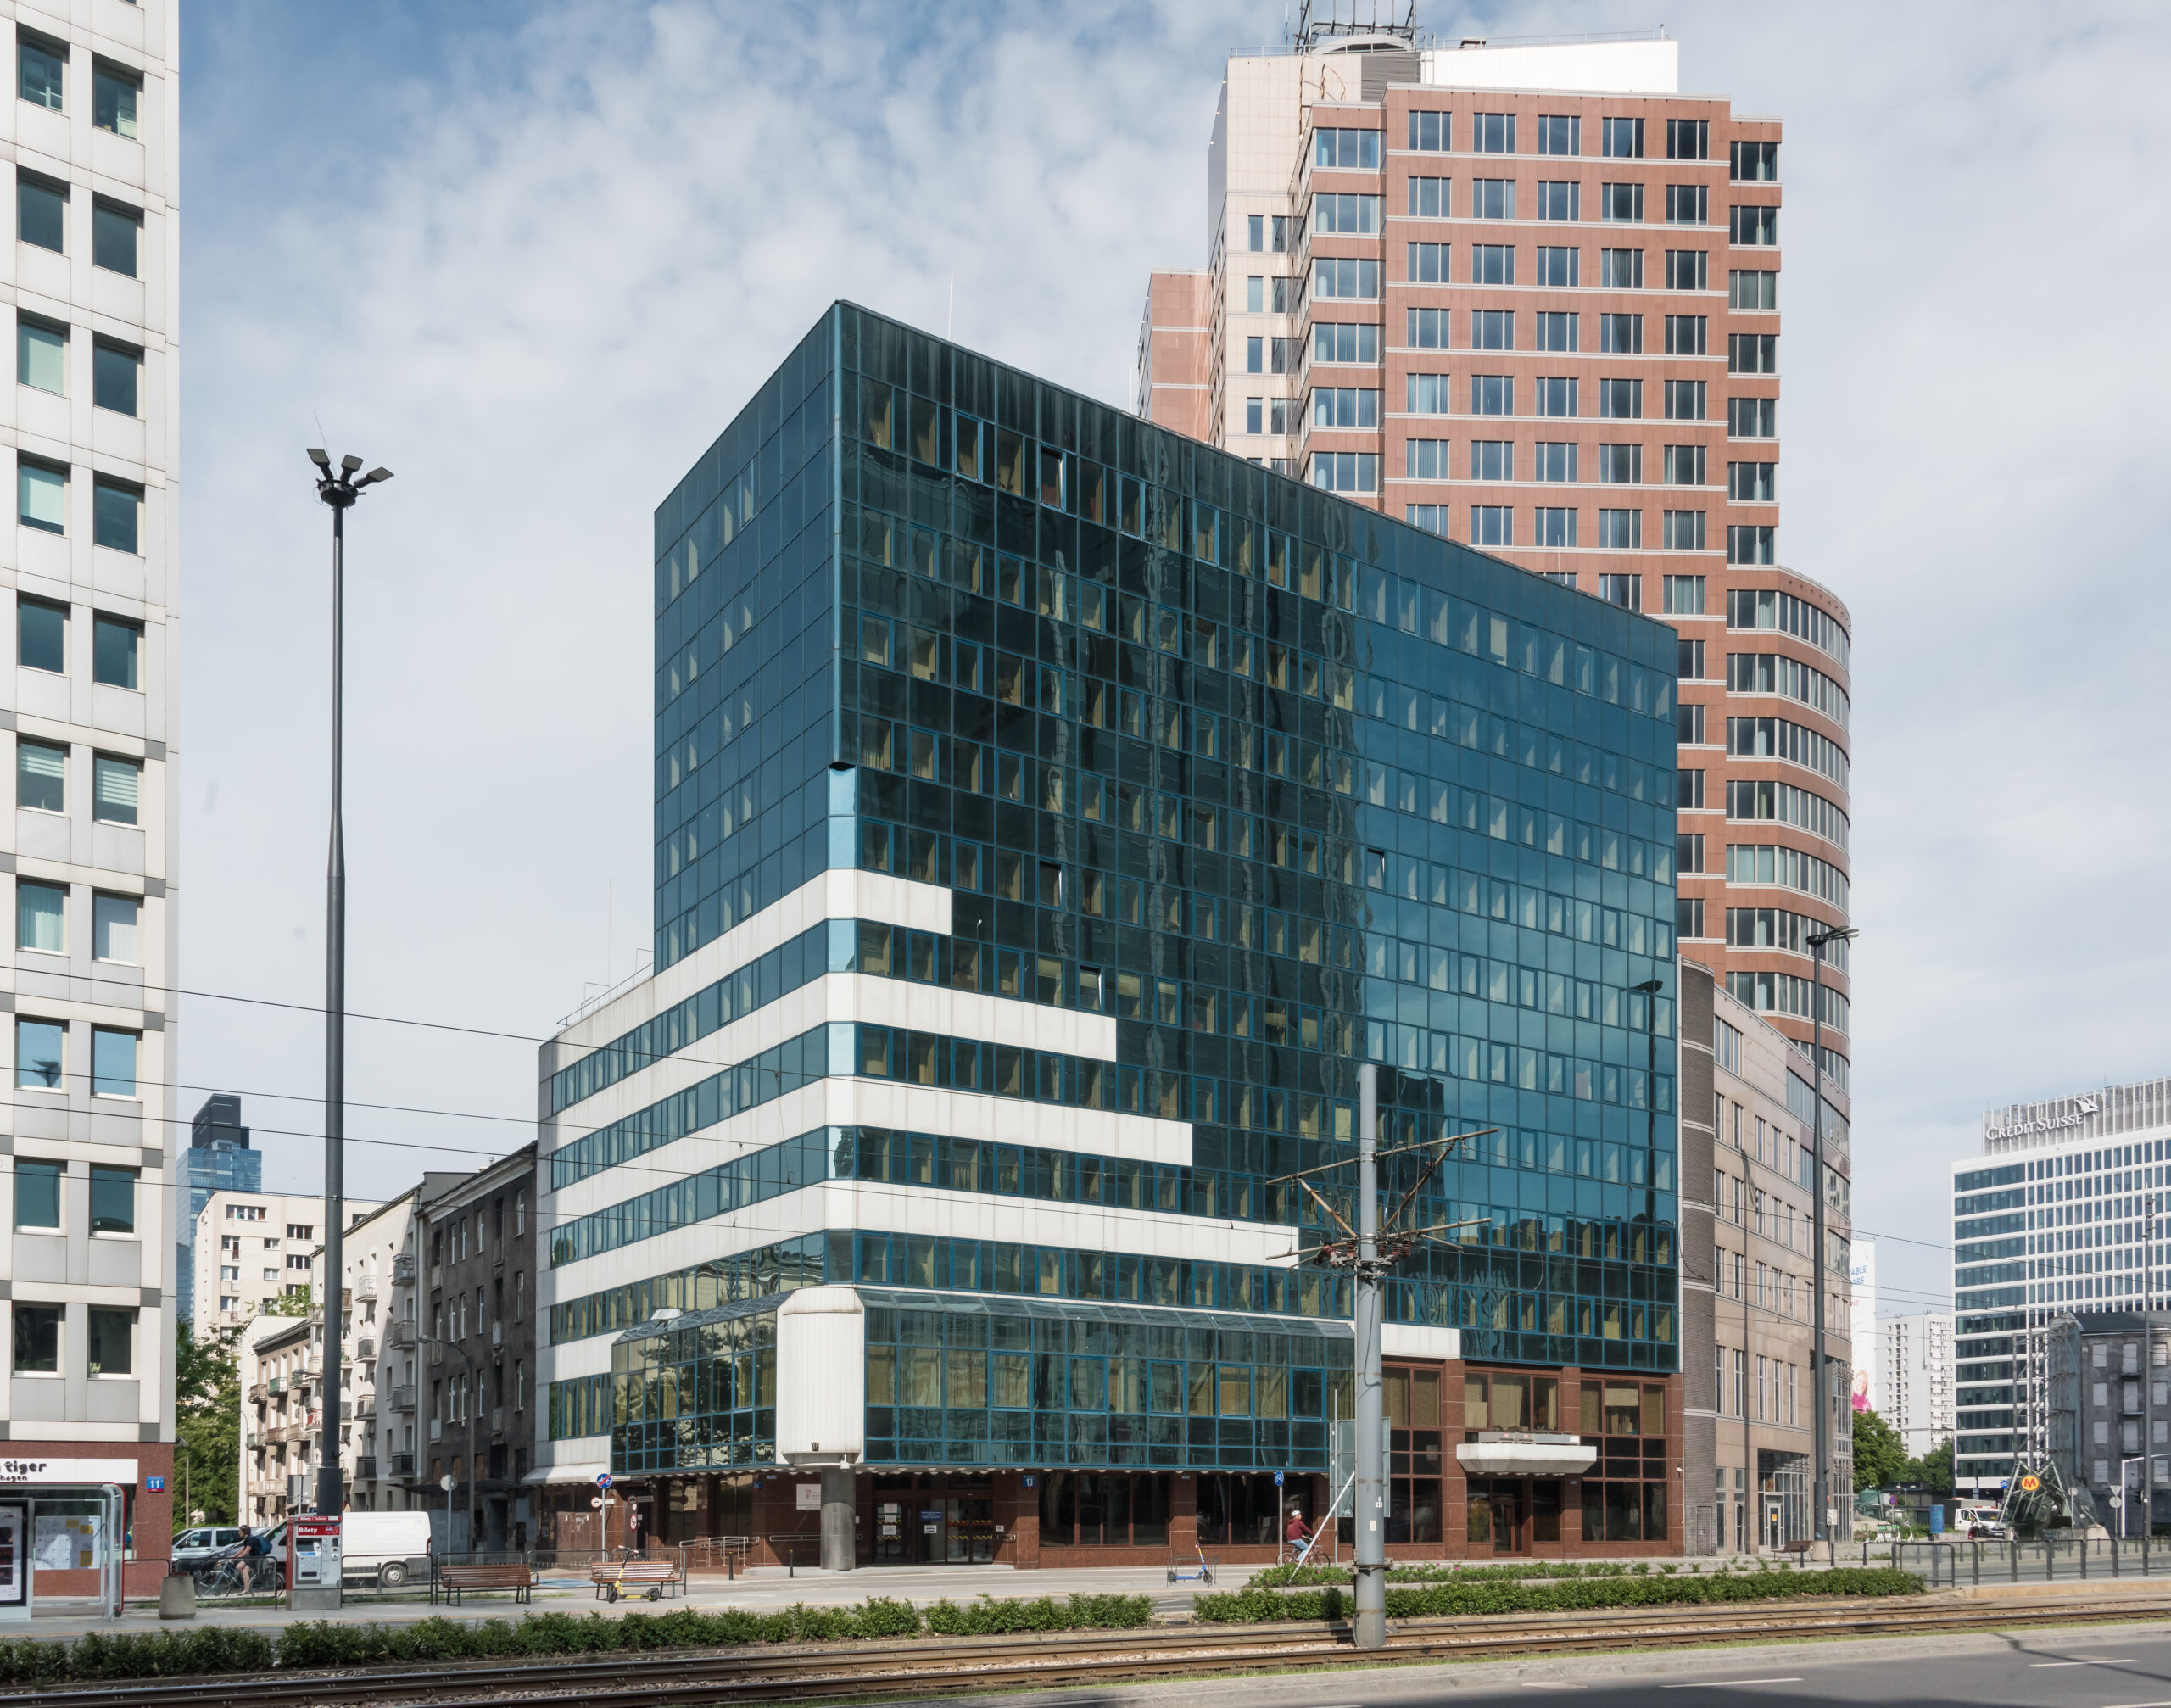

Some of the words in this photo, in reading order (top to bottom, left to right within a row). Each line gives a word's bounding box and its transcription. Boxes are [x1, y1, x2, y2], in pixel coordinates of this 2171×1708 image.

[1986, 1121, 2036, 1140] CREDIT
[2036, 1113, 2084, 1131] SUISSE
[4, 1460, 47, 1475] tiger
[150, 1480, 159, 1488] 11
[2023, 1478, 2036, 1488] M
